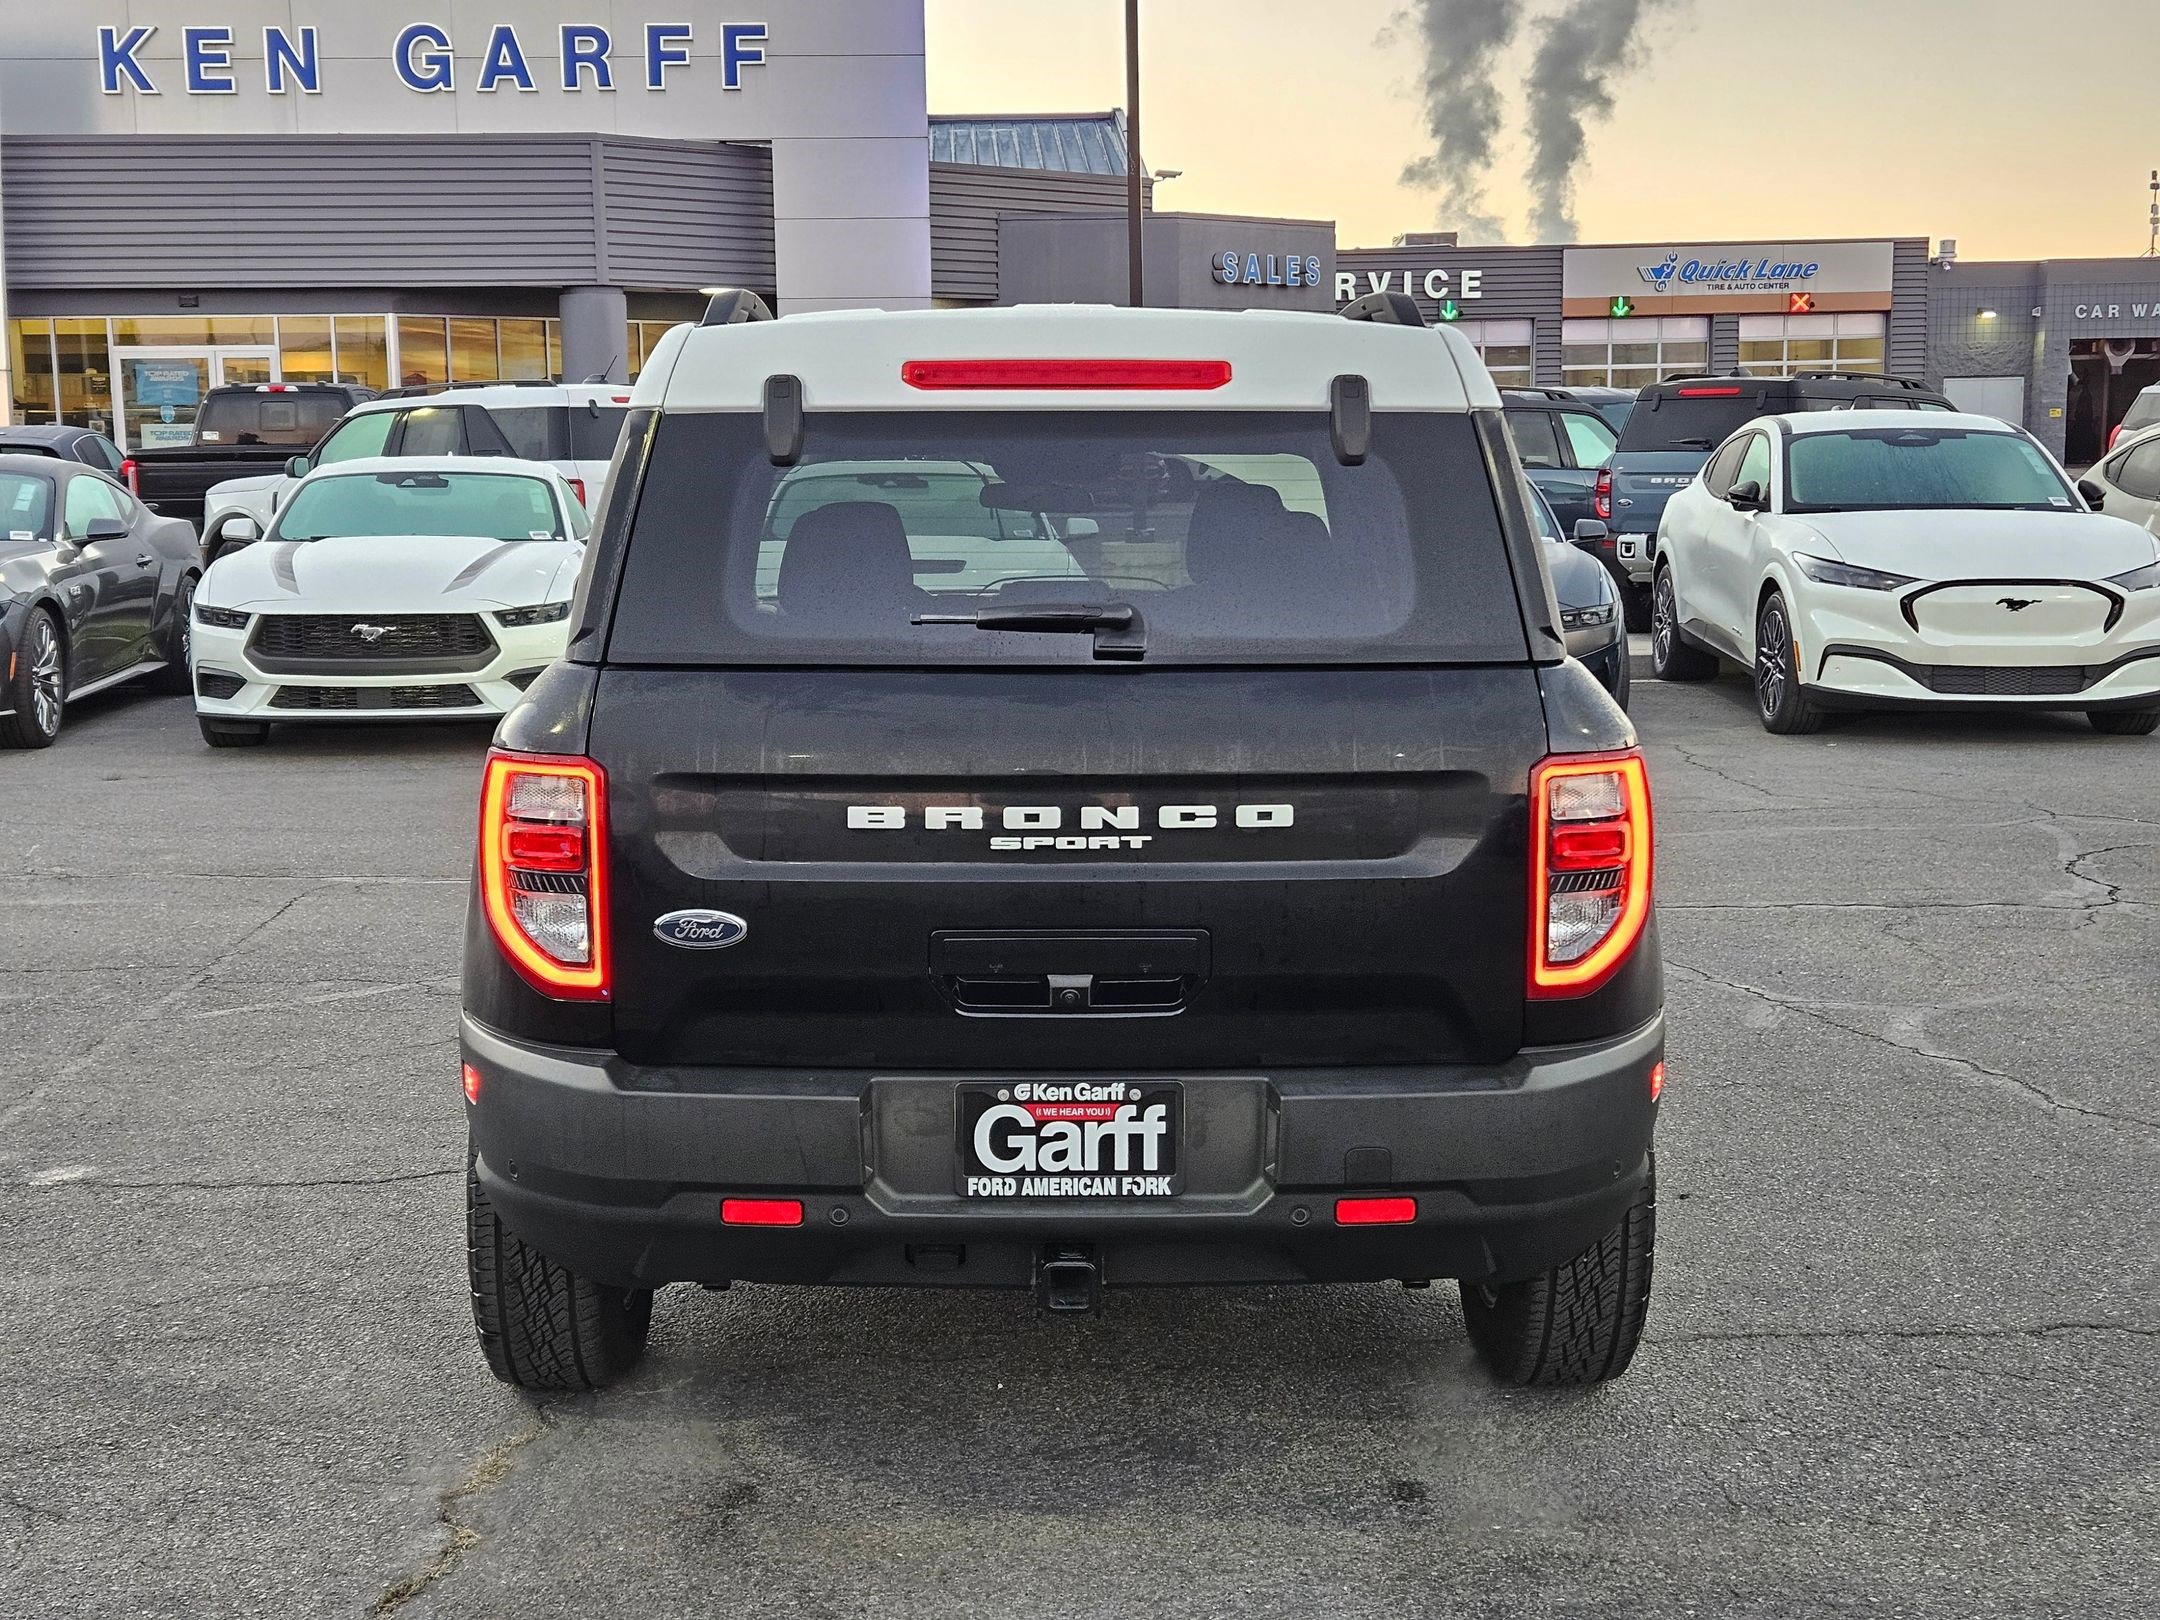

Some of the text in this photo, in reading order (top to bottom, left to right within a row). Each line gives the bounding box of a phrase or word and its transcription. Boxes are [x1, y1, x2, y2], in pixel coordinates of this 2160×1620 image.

[97, 22, 771, 95] KEN GARFF
[1222, 251, 1321, 287] SALES
[1679, 257, 1820, 284] Quick Lane
[1758, 282, 1790, 290] CENTER
[2075, 304, 2120, 319] CAR
[847, 804, 1294, 830] BRONCO
[990, 836, 1153, 850] SPORT
[674, 917, 724, 939] Ford
[1032, 1083, 1072, 1101] Ken
[1074, 1082, 1126, 1101] Garff
[1042, 1107, 1104, 1116] WE HEAR YOU
[973, 1104, 1167, 1174] Garff
[967, 1176, 1172, 1197] FORD AMERICAN FORK
